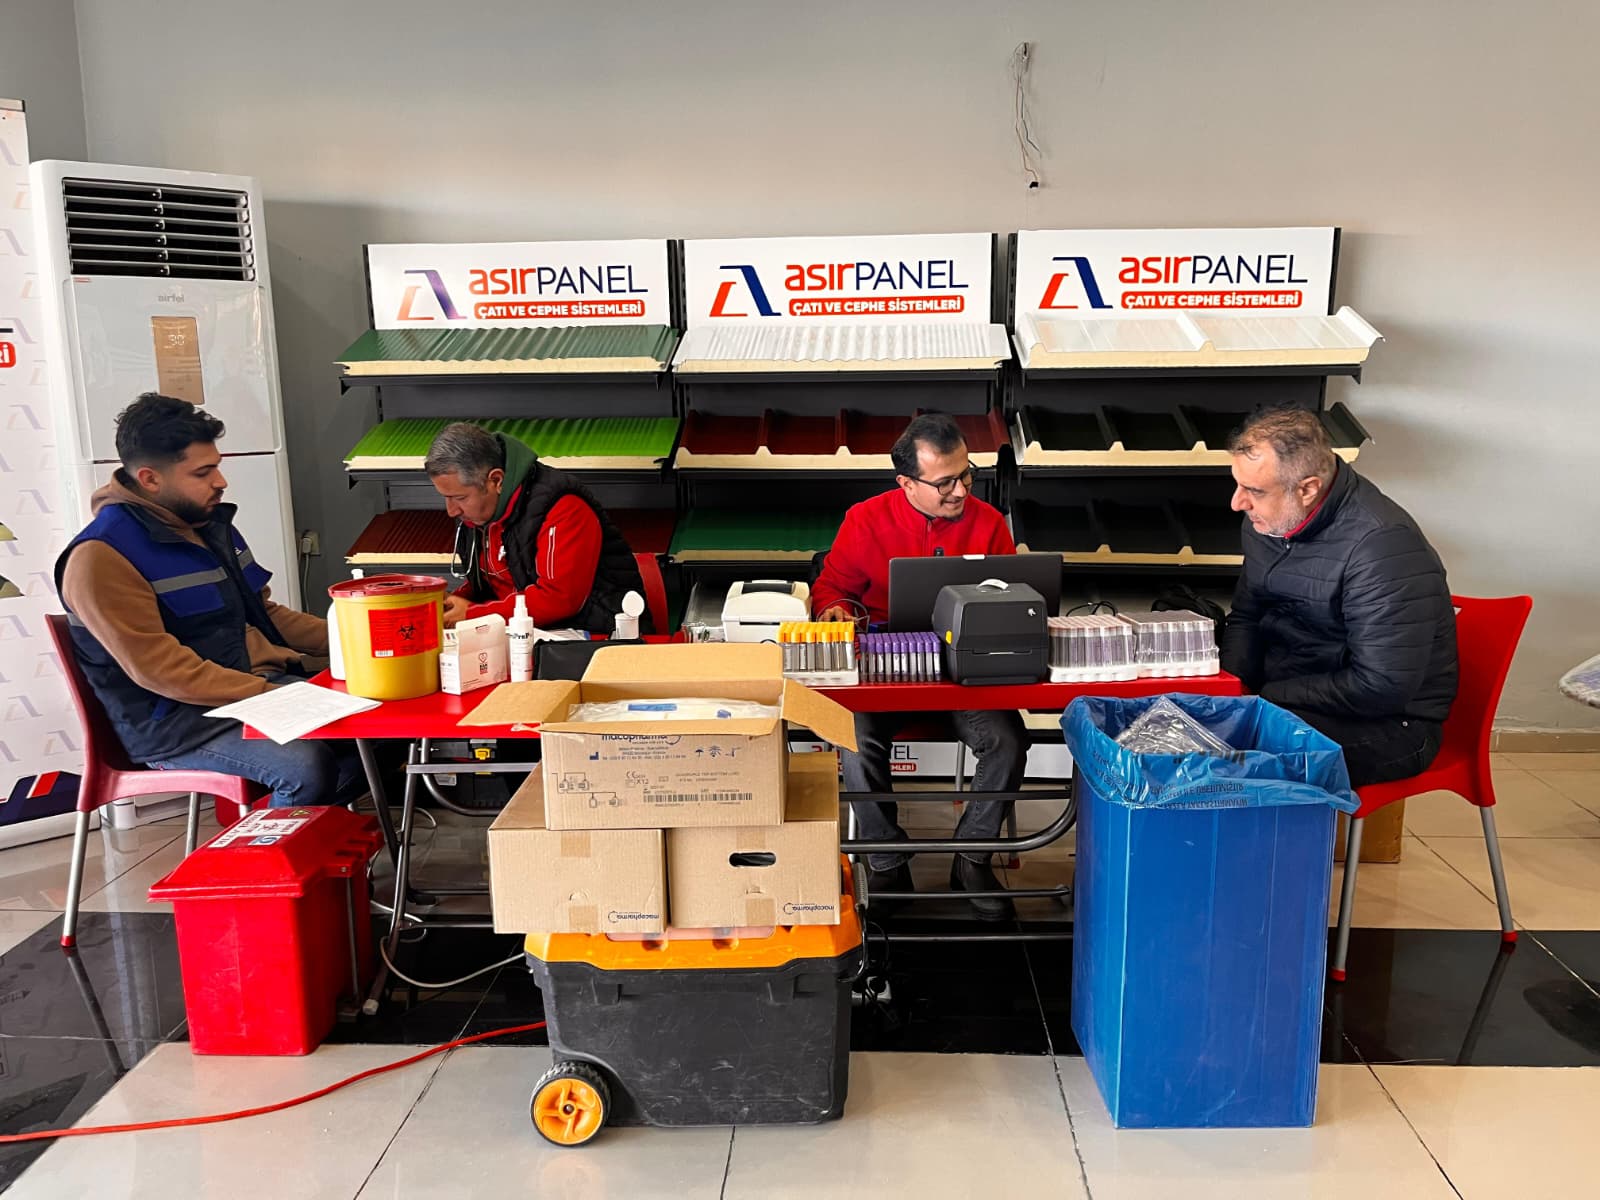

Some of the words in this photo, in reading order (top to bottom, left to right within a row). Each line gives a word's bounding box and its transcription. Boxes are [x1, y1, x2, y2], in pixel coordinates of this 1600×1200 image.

[793, 301, 824, 316] ÇATI
[825, 300, 842, 313] VE
[843, 299, 886, 313] CEPHE
[887, 298, 961, 311] SİSTEMLERİ
[1125, 295, 1156, 309] ÇATI
[1158, 295, 1175, 305] VE
[1177, 294, 1220, 306] CEPHE
[1223, 292, 1299, 306] SİSTEMLERİ
[478, 305, 507, 319] ÇATI
[509, 304, 527, 316] VE
[529, 303, 569, 316] CEPHE
[571, 301, 642, 315] SİSTEMLERİ
[894, 745, 919, 760] EL
